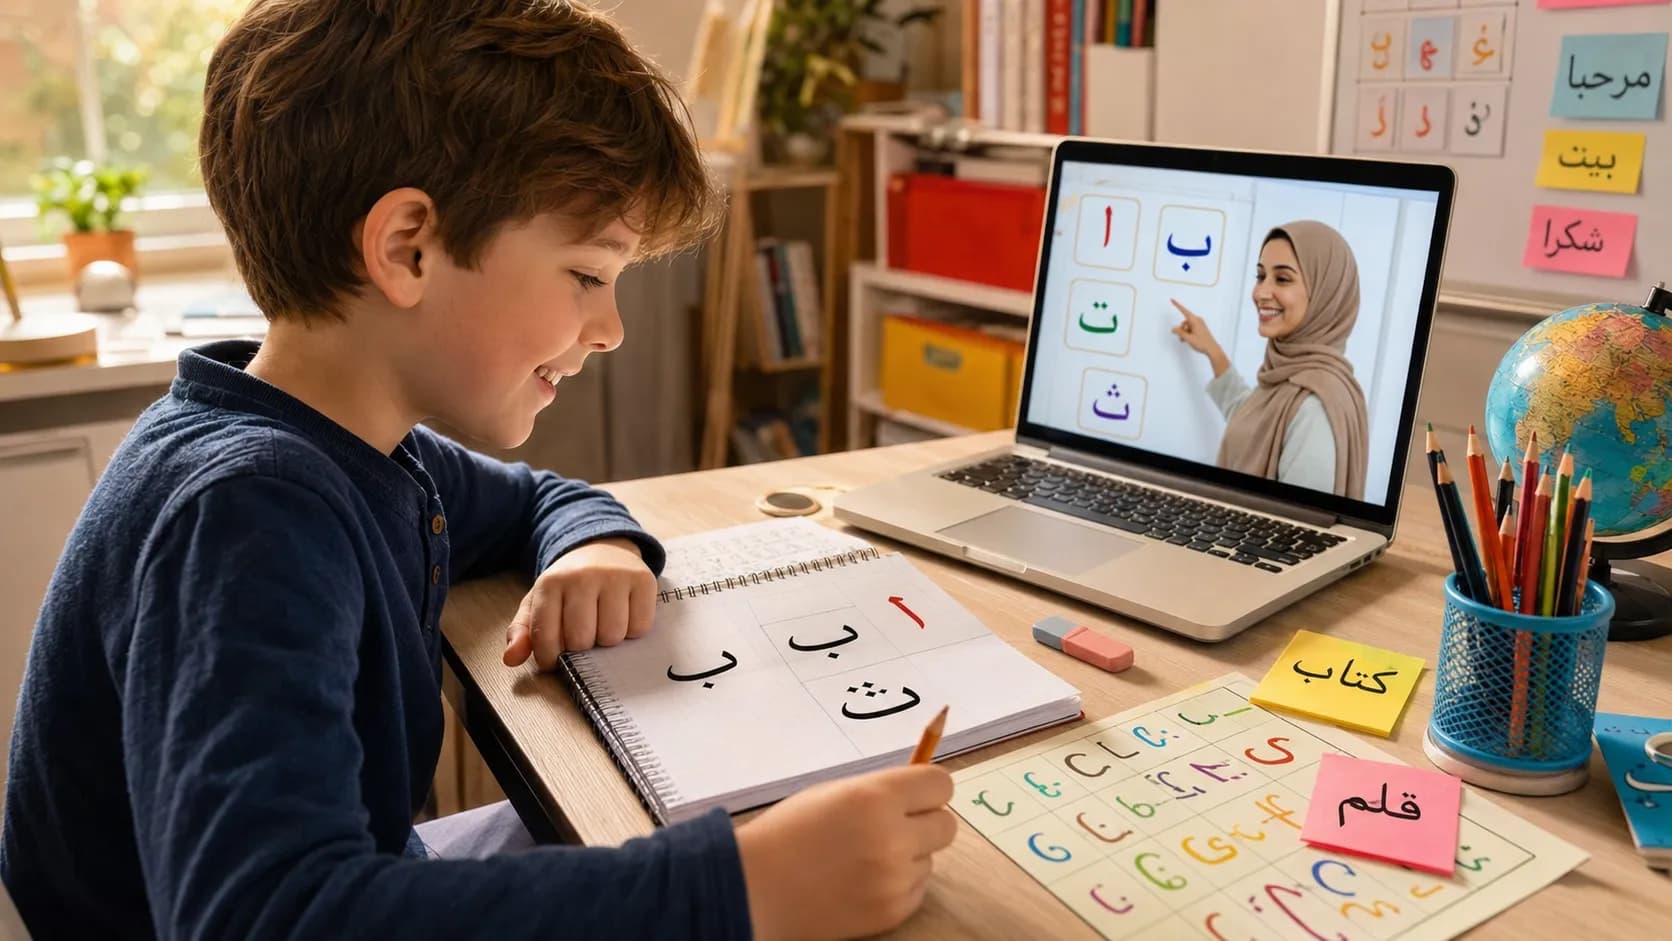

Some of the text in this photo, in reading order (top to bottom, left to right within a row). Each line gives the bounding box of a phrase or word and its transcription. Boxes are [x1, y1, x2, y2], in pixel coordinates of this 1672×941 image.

[1568, 54, 1651, 99] مرحبا
[1558, 146, 1617, 179] بيت
[1103, 205, 1113, 248] ا
[1543, 219, 1604, 258] شكرا
[1166, 233, 1212, 272] ب
[1078, 301, 1118, 335] ت
[1092, 383, 1130, 421] ث
[888, 596, 925, 629] ا
[788, 624, 859, 660] ب
[666, 650, 738, 690] ب
[1292, 658, 1398, 694] كتاب
[1337, 782, 1422, 828] قلم
